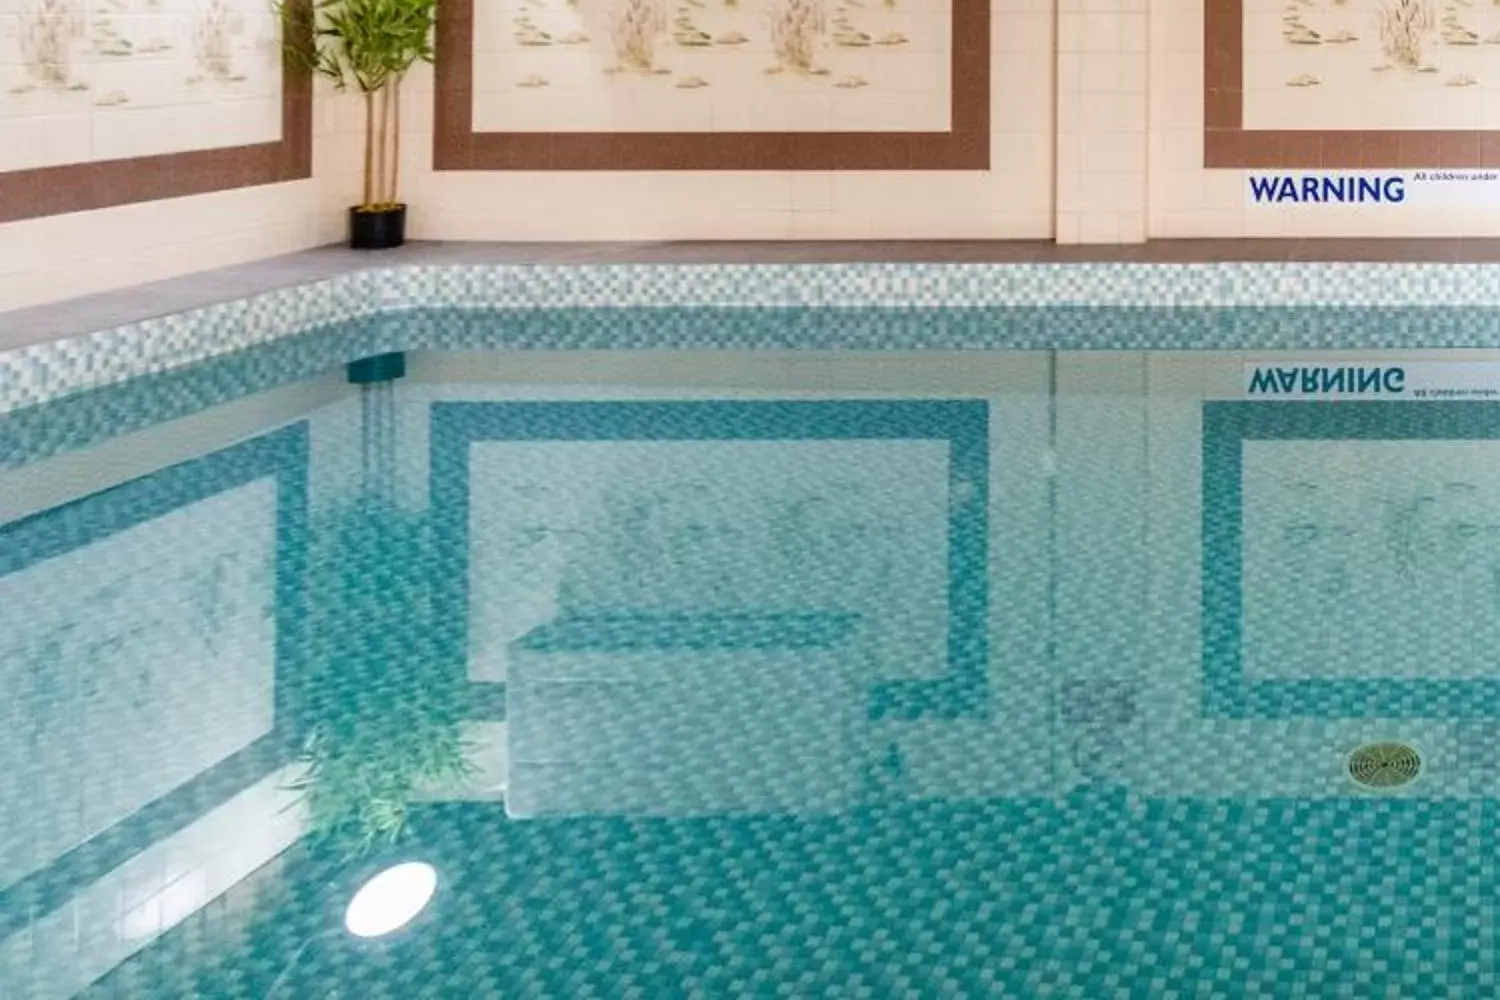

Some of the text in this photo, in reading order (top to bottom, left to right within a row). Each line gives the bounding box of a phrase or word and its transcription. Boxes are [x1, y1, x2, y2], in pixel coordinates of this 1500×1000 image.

[1414, 172, 1427, 181] All
[1429, 172, 1469, 181] children
[1471, 172, 1498, 181] under
[1249, 176, 1406, 203] WARNING
